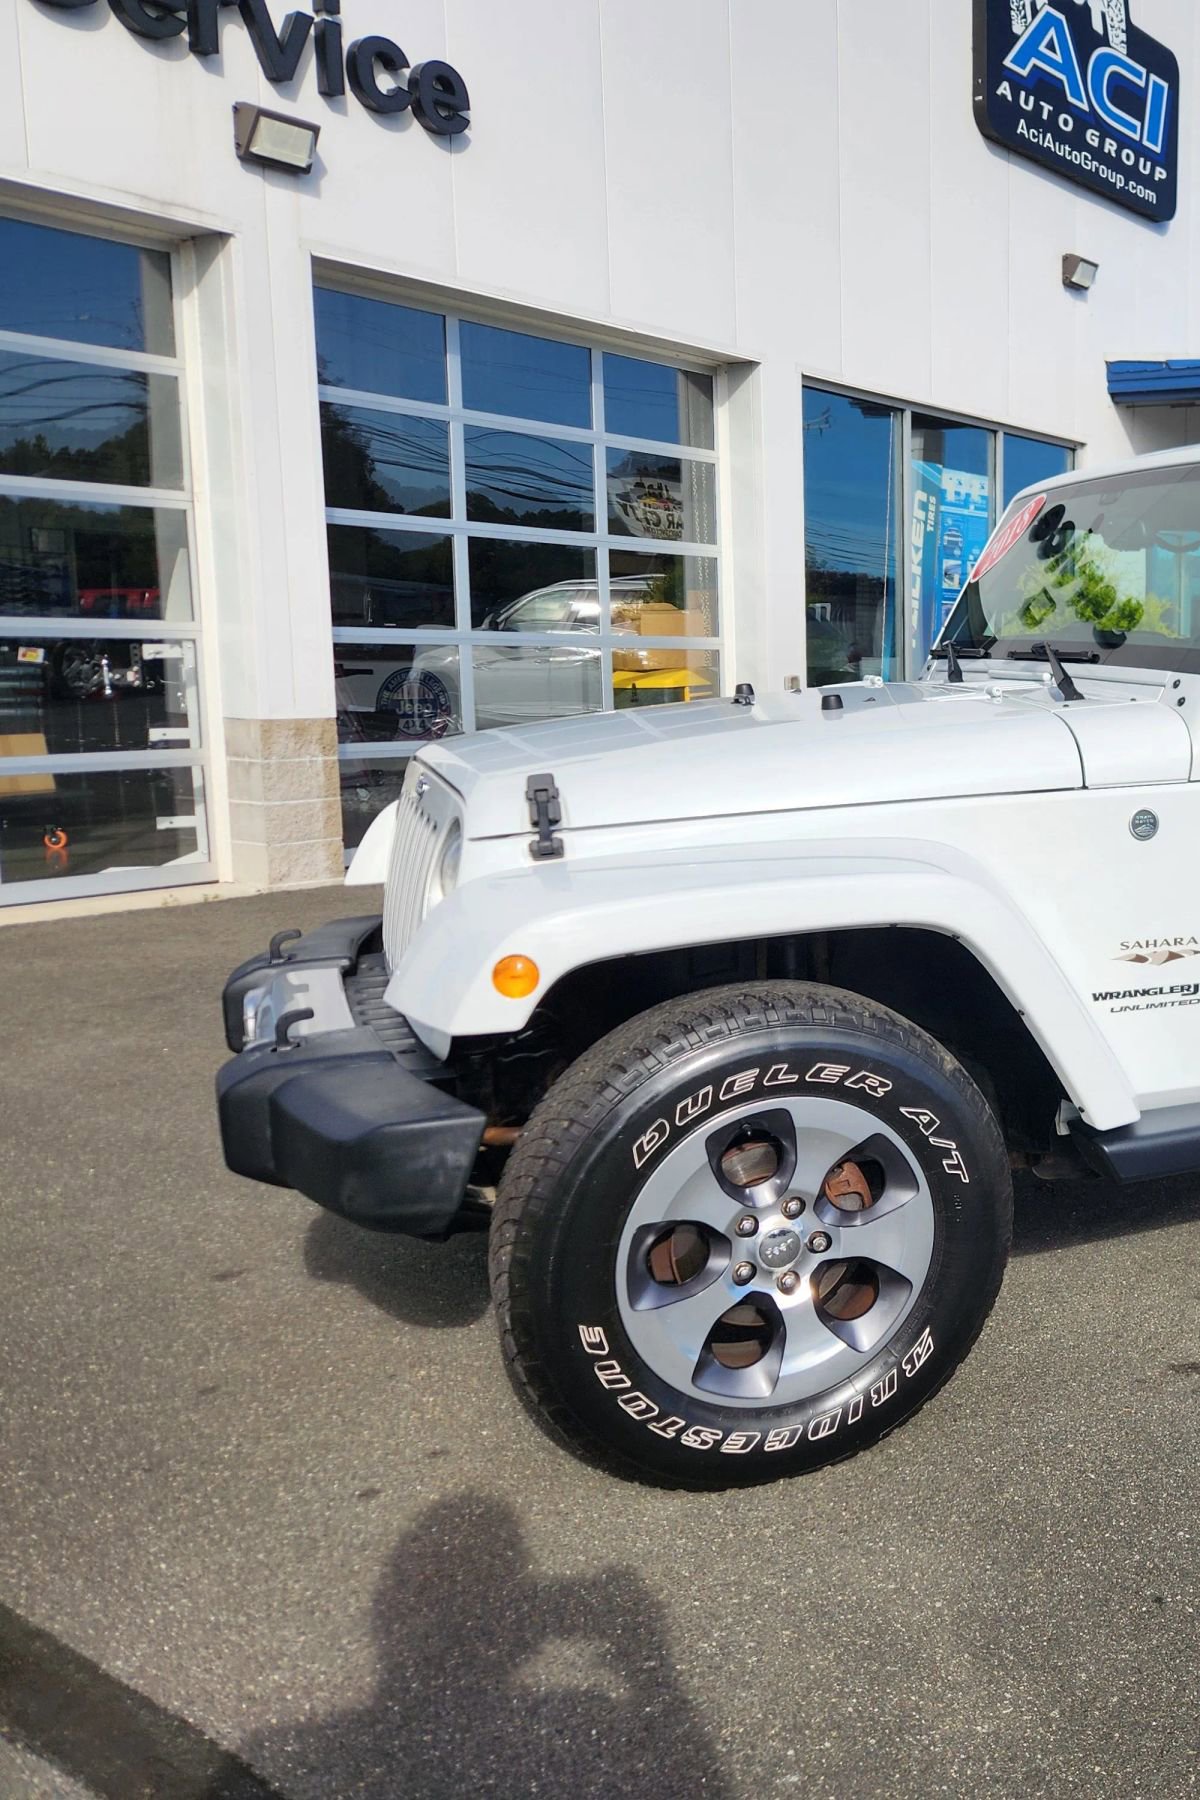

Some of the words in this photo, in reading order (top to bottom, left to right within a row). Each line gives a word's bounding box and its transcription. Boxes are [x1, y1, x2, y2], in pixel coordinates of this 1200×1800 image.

[28, 0, 470, 136] ervice
[1002, 4, 1169, 154] ACI
[995, 80, 1074, 132] AUTO
[1085, 128, 1168, 182] GROUP
[1016, 118, 1158, 205] AciAutoGroup.com
[927, 495, 937, 532] TIRES
[1120, 936, 1199, 950] SAHARA
[1110, 999, 1200, 1013] UNLIMITED
[631, 1062, 893, 1170] DUELER
[578, 1325, 937, 1455] BRIDGESTONE
